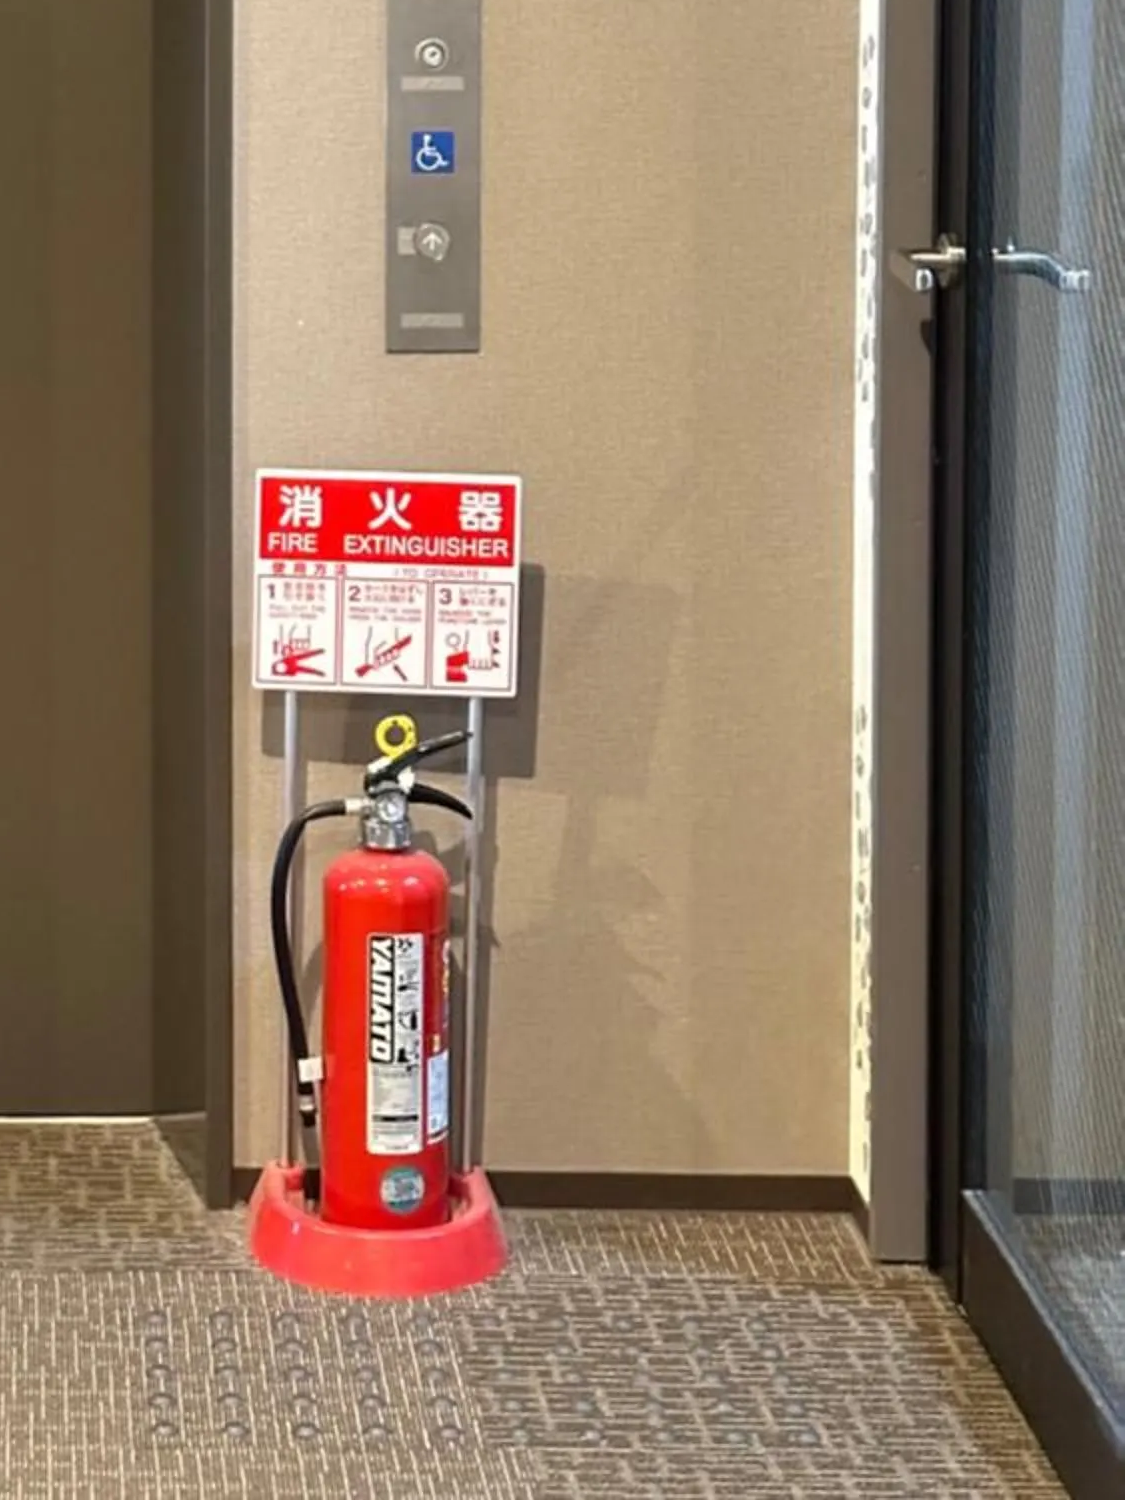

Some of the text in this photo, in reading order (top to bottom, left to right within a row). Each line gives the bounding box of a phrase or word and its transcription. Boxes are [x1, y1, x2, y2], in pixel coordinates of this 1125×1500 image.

[278, 484, 503, 533] 消火器
[268, 531, 509, 558] FIRE EXTINGUISHER
[268, 583, 275, 599] 1
[348, 585, 361, 602] 2
[439, 587, 452, 605] 3
[370, 937, 393, 1062] YAMATO
